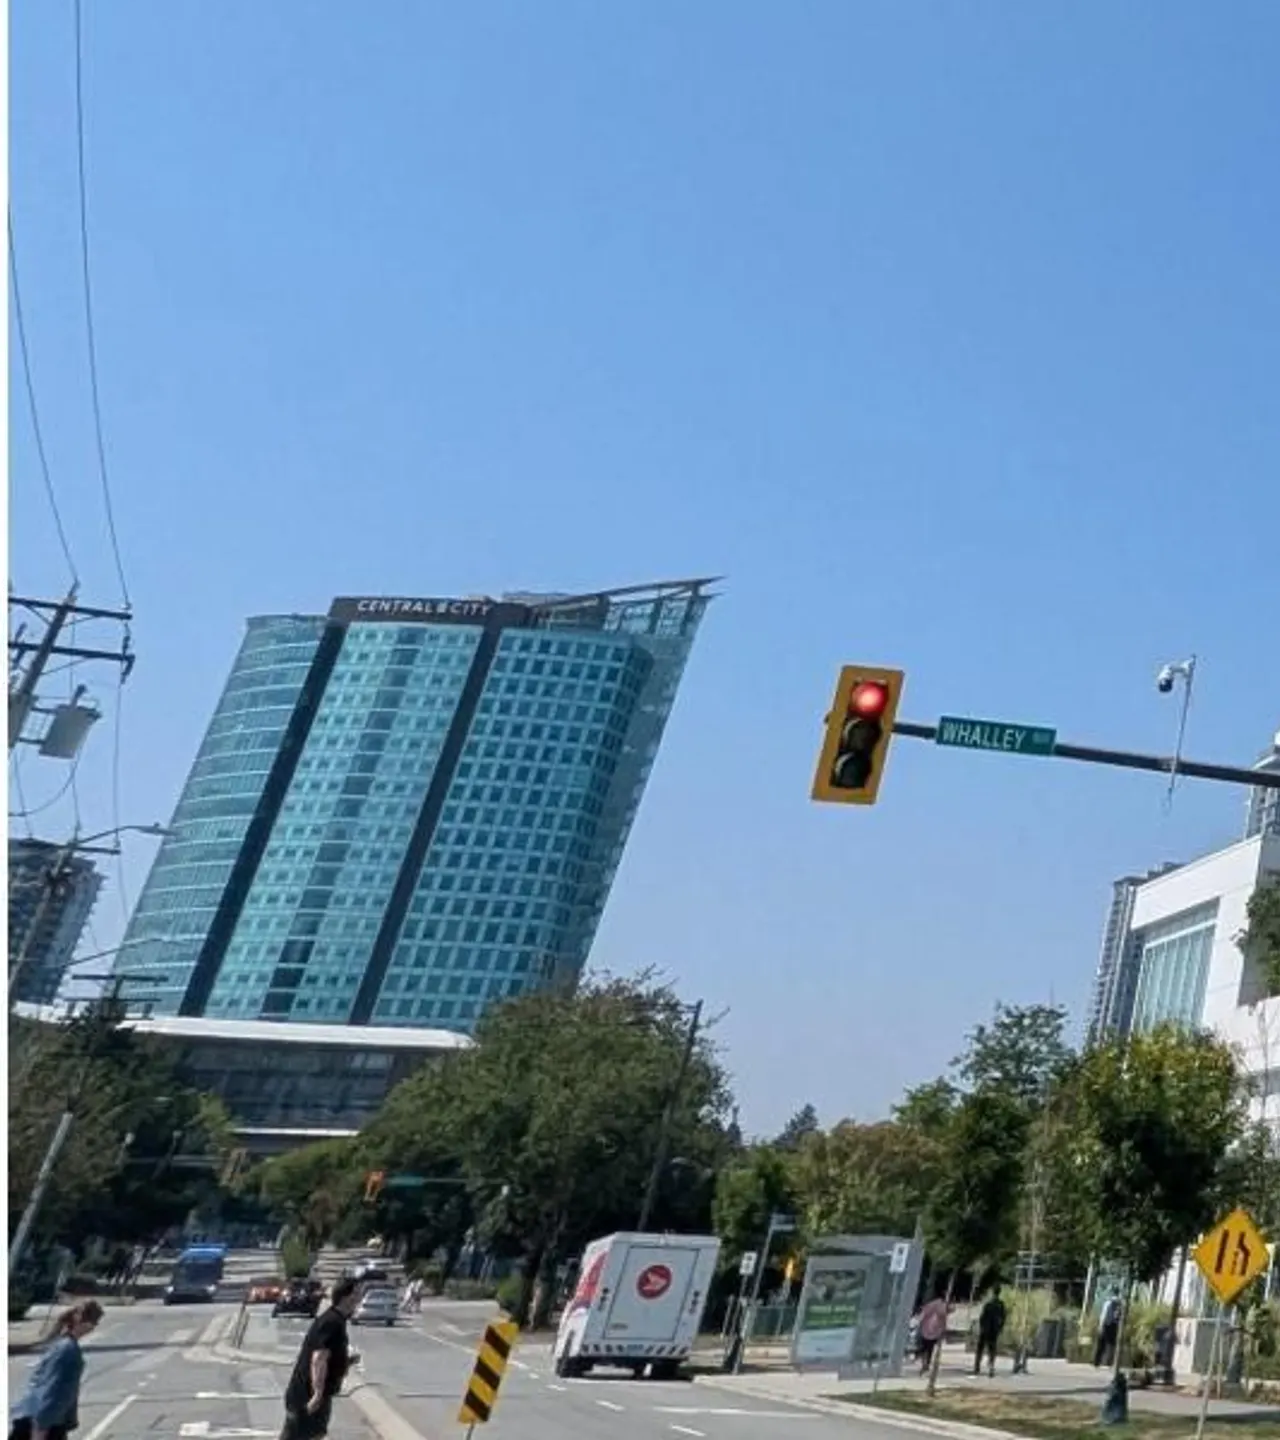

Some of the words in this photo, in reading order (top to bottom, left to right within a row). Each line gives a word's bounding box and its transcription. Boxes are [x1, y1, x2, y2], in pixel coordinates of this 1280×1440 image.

[357, 599, 433, 615] CENTRAL
[450, 602, 491, 616] CITY
[942, 721, 1027, 750] WHALLEY
